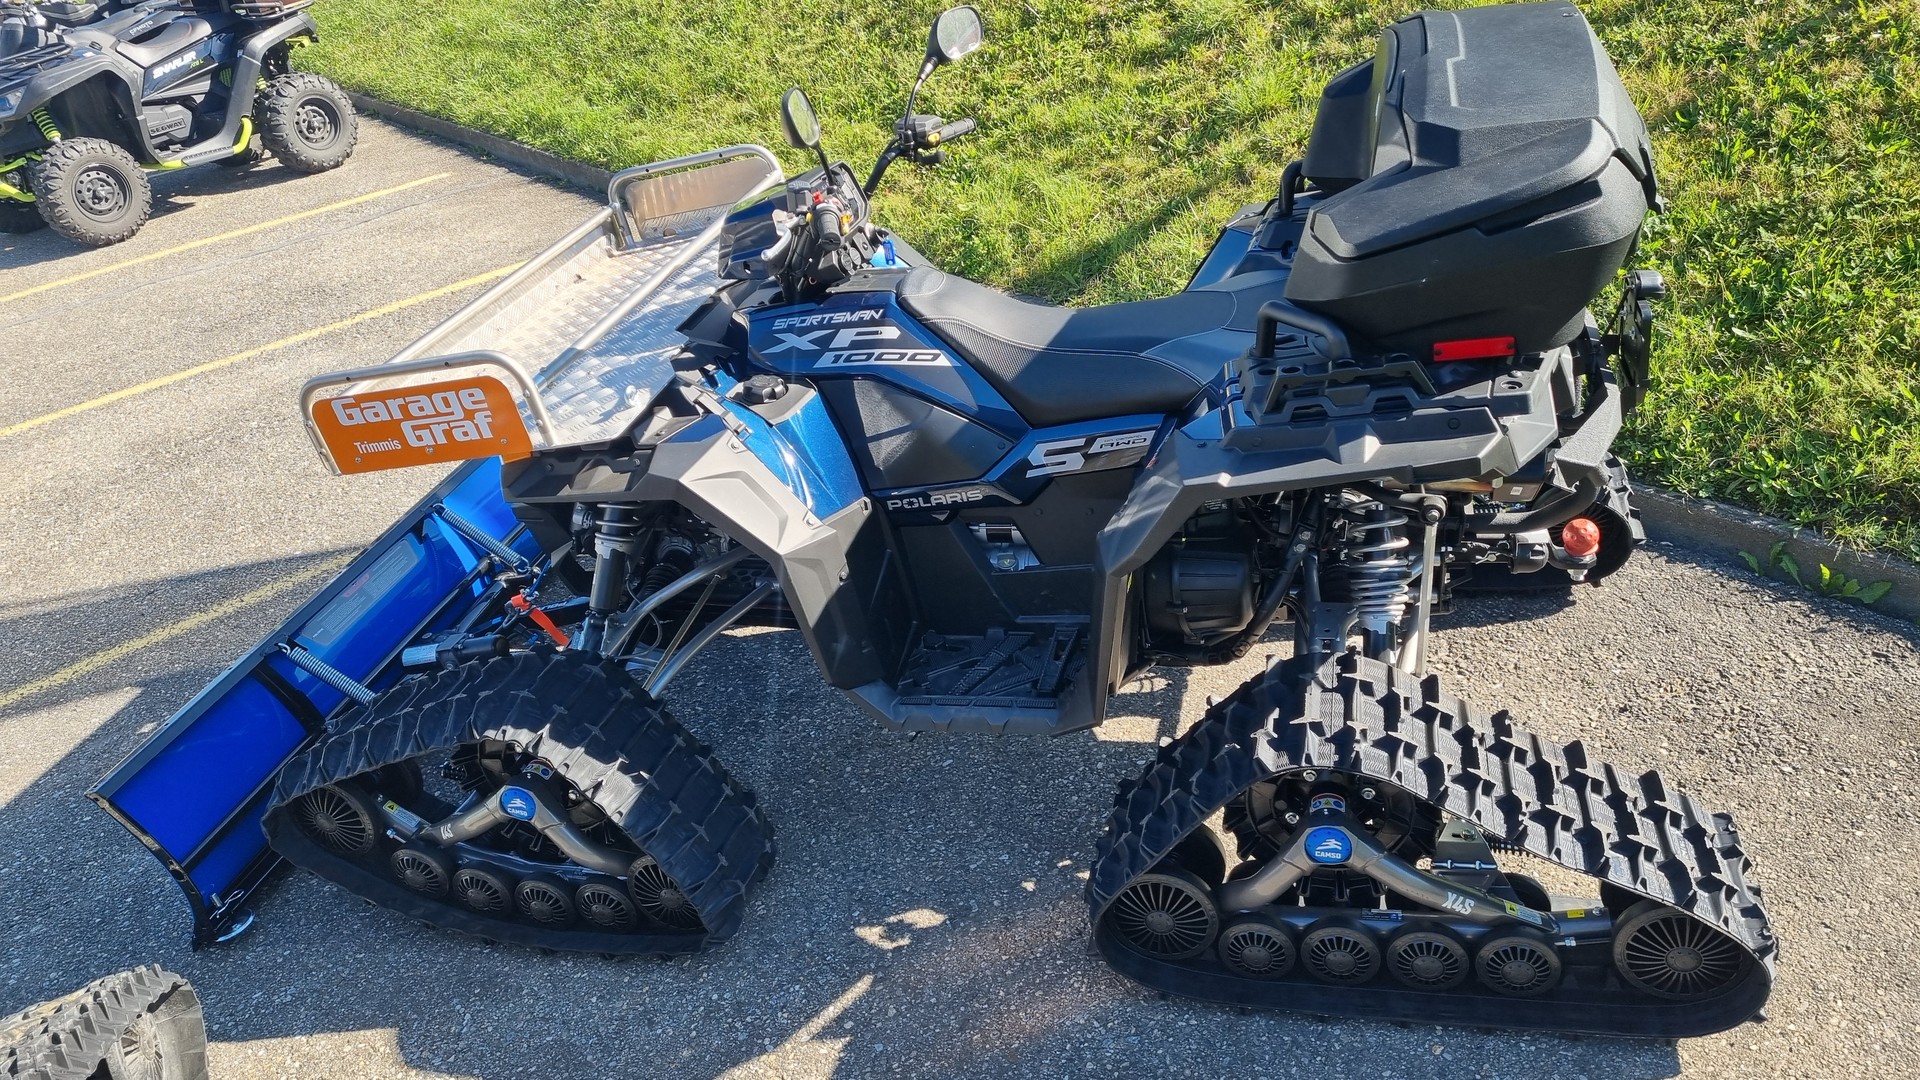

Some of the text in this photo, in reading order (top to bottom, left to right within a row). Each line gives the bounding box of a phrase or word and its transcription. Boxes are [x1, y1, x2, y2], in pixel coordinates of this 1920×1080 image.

[152, 51, 197, 79] SNARLER
[150, 120, 183, 134] SEGWAY
[772, 309, 884, 330] SPORTSMAN
[760, 326, 901, 354] XP
[831, 351, 942, 363] 1000
[331, 388, 488, 426] Garage
[401, 411, 493, 447] Graf
[354, 438, 401, 454] Trimmis
[1099, 438, 1147, 449] AWD
[886, 490, 983, 511] POLARIS
[507, 807, 527, 816] CAMSO
[1315, 850, 1341, 859] CAMSO
[1441, 892, 1475, 915] X4S
